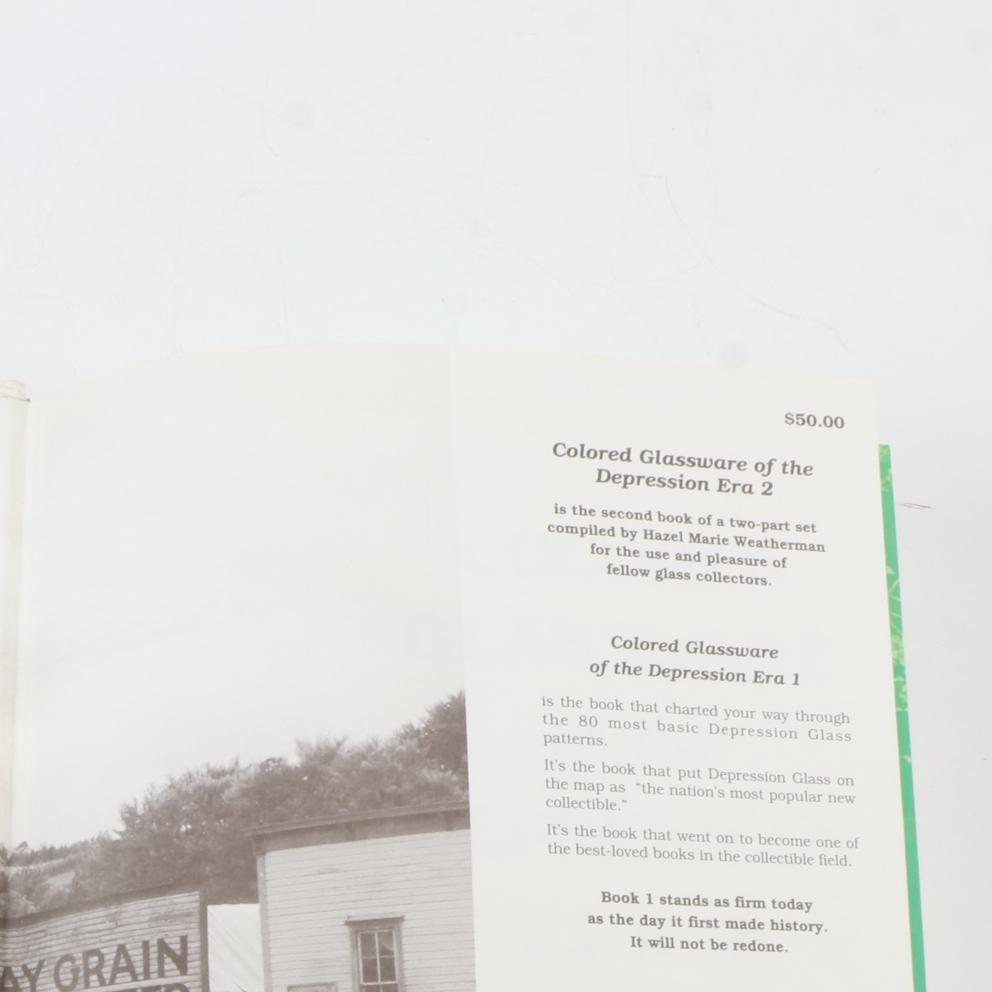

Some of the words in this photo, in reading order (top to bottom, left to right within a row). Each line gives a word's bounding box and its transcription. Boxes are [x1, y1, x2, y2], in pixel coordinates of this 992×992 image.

[784, 411, 845, 429] $50.00
[552, 441, 632, 463] Colored
[639, 448, 748, 472] Glassware
[753, 457, 777, 477] of
[781, 459, 814, 476] the
[595, 468, 710, 492] Depression
[716, 477, 754, 495] Era
[760, 480, 773, 496] 2
[553, 502, 567, 515] is
[571, 504, 596, 517] the
[600, 508, 653, 522] second
[656, 510, 693, 525] book
[697, 514, 713, 526] of
[716, 518, 725, 527] a
[729, 517, 790, 533] two-part
[794, 522, 817, 533] set
[546, 523, 616, 538] compiled
[619, 526, 638, 542] by
[642, 528, 683, 543] Hazel
[688, 531, 729, 546] Marie
[733, 535, 826, 552] Weatherman
[590, 542, 611, 556] for
[615, 545, 640, 558] the
[644, 550, 670, 560] use
[674, 550, 702, 563] and
[706, 552, 768, 567] pleasure
[772, 556, 788, 569] of
[605, 562, 650, 578] fellow
[654, 567, 691, 582] glass
[695, 570, 772, 586] collectors.
[610, 635, 680, 653] Colored
[685, 640, 779, 659] Glassware
[589, 659, 610, 677] of
[613, 661, 643, 676] the
[647, 663, 747, 683] Depression
[752, 670, 785, 685] Era
[791, 672, 800, 686] 1
[541, 695, 554, 707] is
[560, 695, 583, 709] the
[588, 696, 624, 711] book
[629, 699, 659, 714] that
[664, 701, 718, 717] charted
[723, 708, 757, 721] your
[761, 710, 789, 724] way
[794, 709, 850, 727] through
[542, 712, 568, 726] the
[578, 714, 598, 728] 80
[607, 719, 646, 731] most
[655, 719, 699, 734] basic
[708, 722, 798, 740] Depression
[807, 728, 852, 742] Glass
[543, 733, 608, 747] patterns.
[600, 890, 640, 904] Book
[646, 892, 654, 905] 1
[659, 894, 709, 907] stands
[713, 898, 730, 908] as
[734, 895, 767, 909] firm
[770, 897, 813, 914] today
[587, 914, 604, 925] as
[608, 912, 634, 926] the
[639, 913, 666, 930] day
[671, 914, 683, 928] it
[687, 915, 720, 929] first
[724, 918, 765, 930] made
[769, 918, 828, 935] history.
[630, 935, 643, 948] It
[647, 936, 675, 949] will
[679, 938, 706, 950] not
[709, 937, 728, 951] be
[732, 939, 788, 953] redone.
[53, 935, 189, 992] GRAIN
